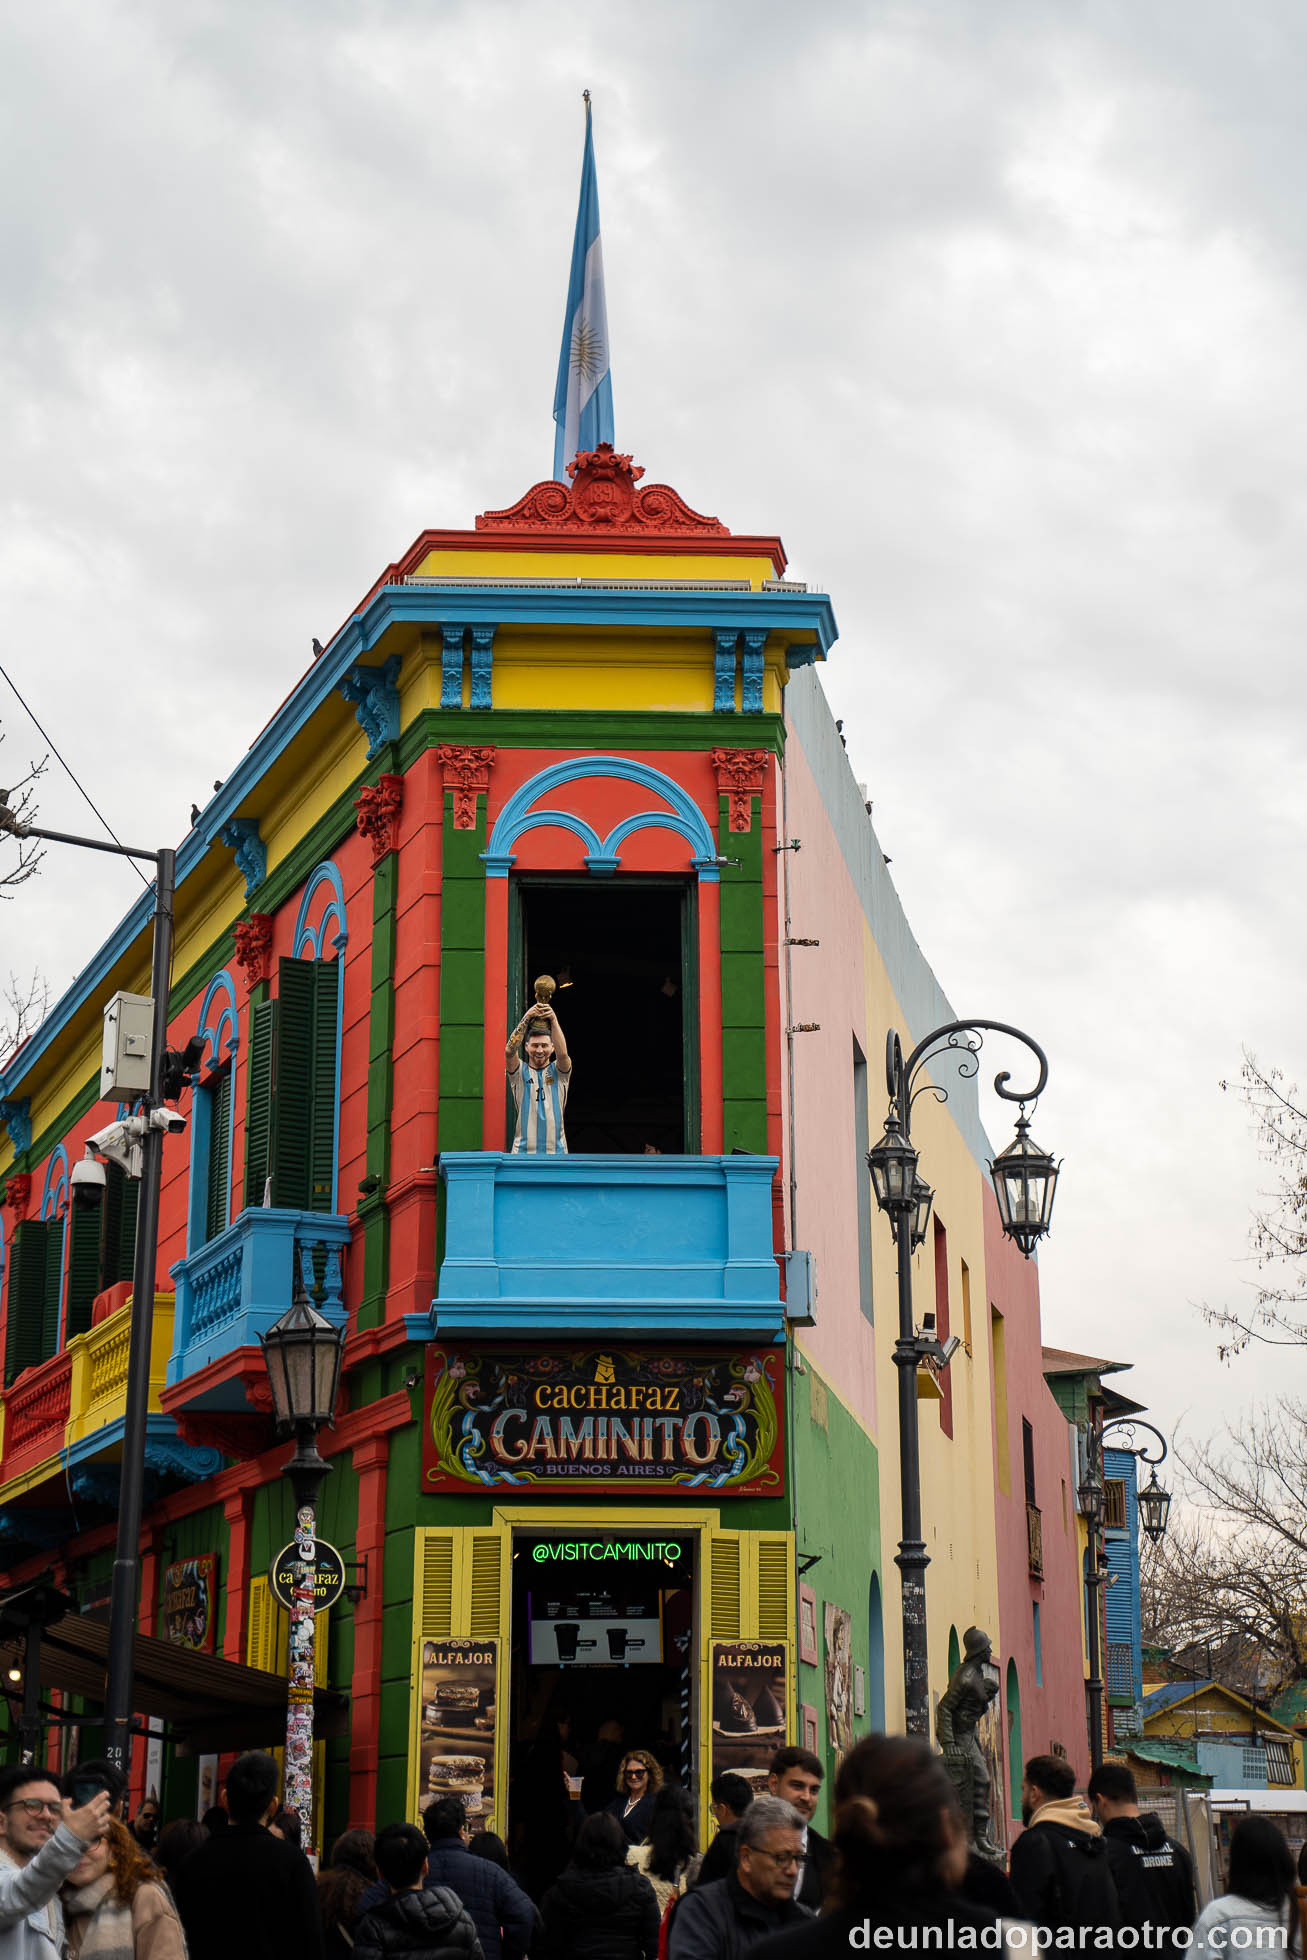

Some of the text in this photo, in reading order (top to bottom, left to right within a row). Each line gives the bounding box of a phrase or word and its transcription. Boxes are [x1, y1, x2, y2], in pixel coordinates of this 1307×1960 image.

[536, 1087, 546, 1102] 10
[488, 1408, 723, 1465] CAMINITO
[546, 1464, 665, 1476] BUENOS AIRES
[532, 1543, 682, 1563] @VISITCAMINITO
[429, 1652, 493, 1665] ALFAJOR
[718, 1654, 782, 1667] ALFAJOR
[106, 1746, 122, 1758] 20
[1142, 1855, 1174, 1868] DRONE
